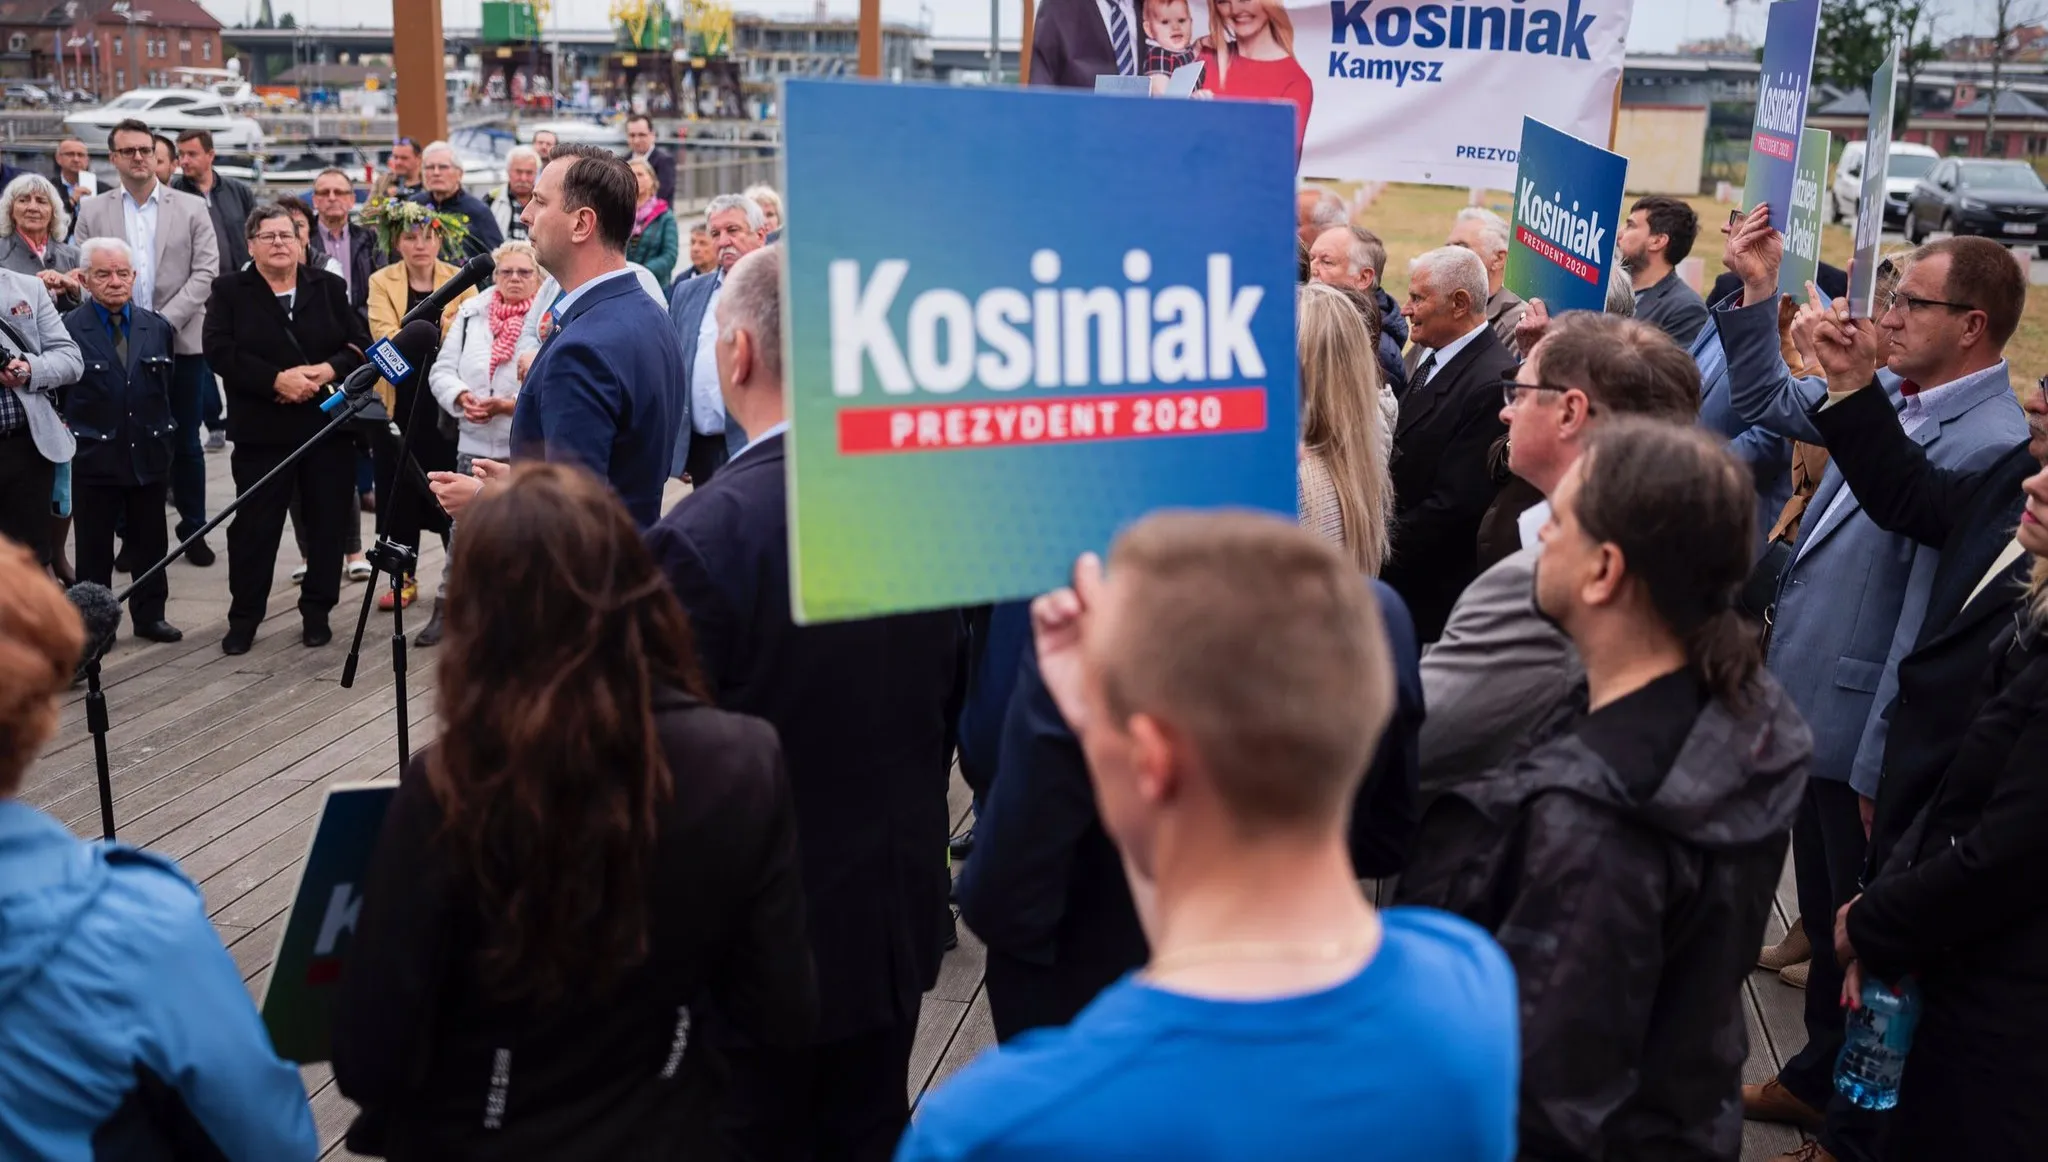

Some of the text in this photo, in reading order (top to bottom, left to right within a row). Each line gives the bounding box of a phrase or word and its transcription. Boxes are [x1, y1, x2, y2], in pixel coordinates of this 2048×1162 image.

[1331, 0, 1597, 60] Kosiniak
[1328, 51, 1444, 87] Kamysz
[1756, 72, 1802, 135] Kosiniak
[1456, 145, 1520, 163] PREZYD
[1518, 177, 1605, 264] Kosiniak
[1523, 231, 1587, 277] PREZYDENT 2020
[829, 249, 1267, 396] Kosiniak
[890, 396, 1222, 447] PREZYDENT 2020
